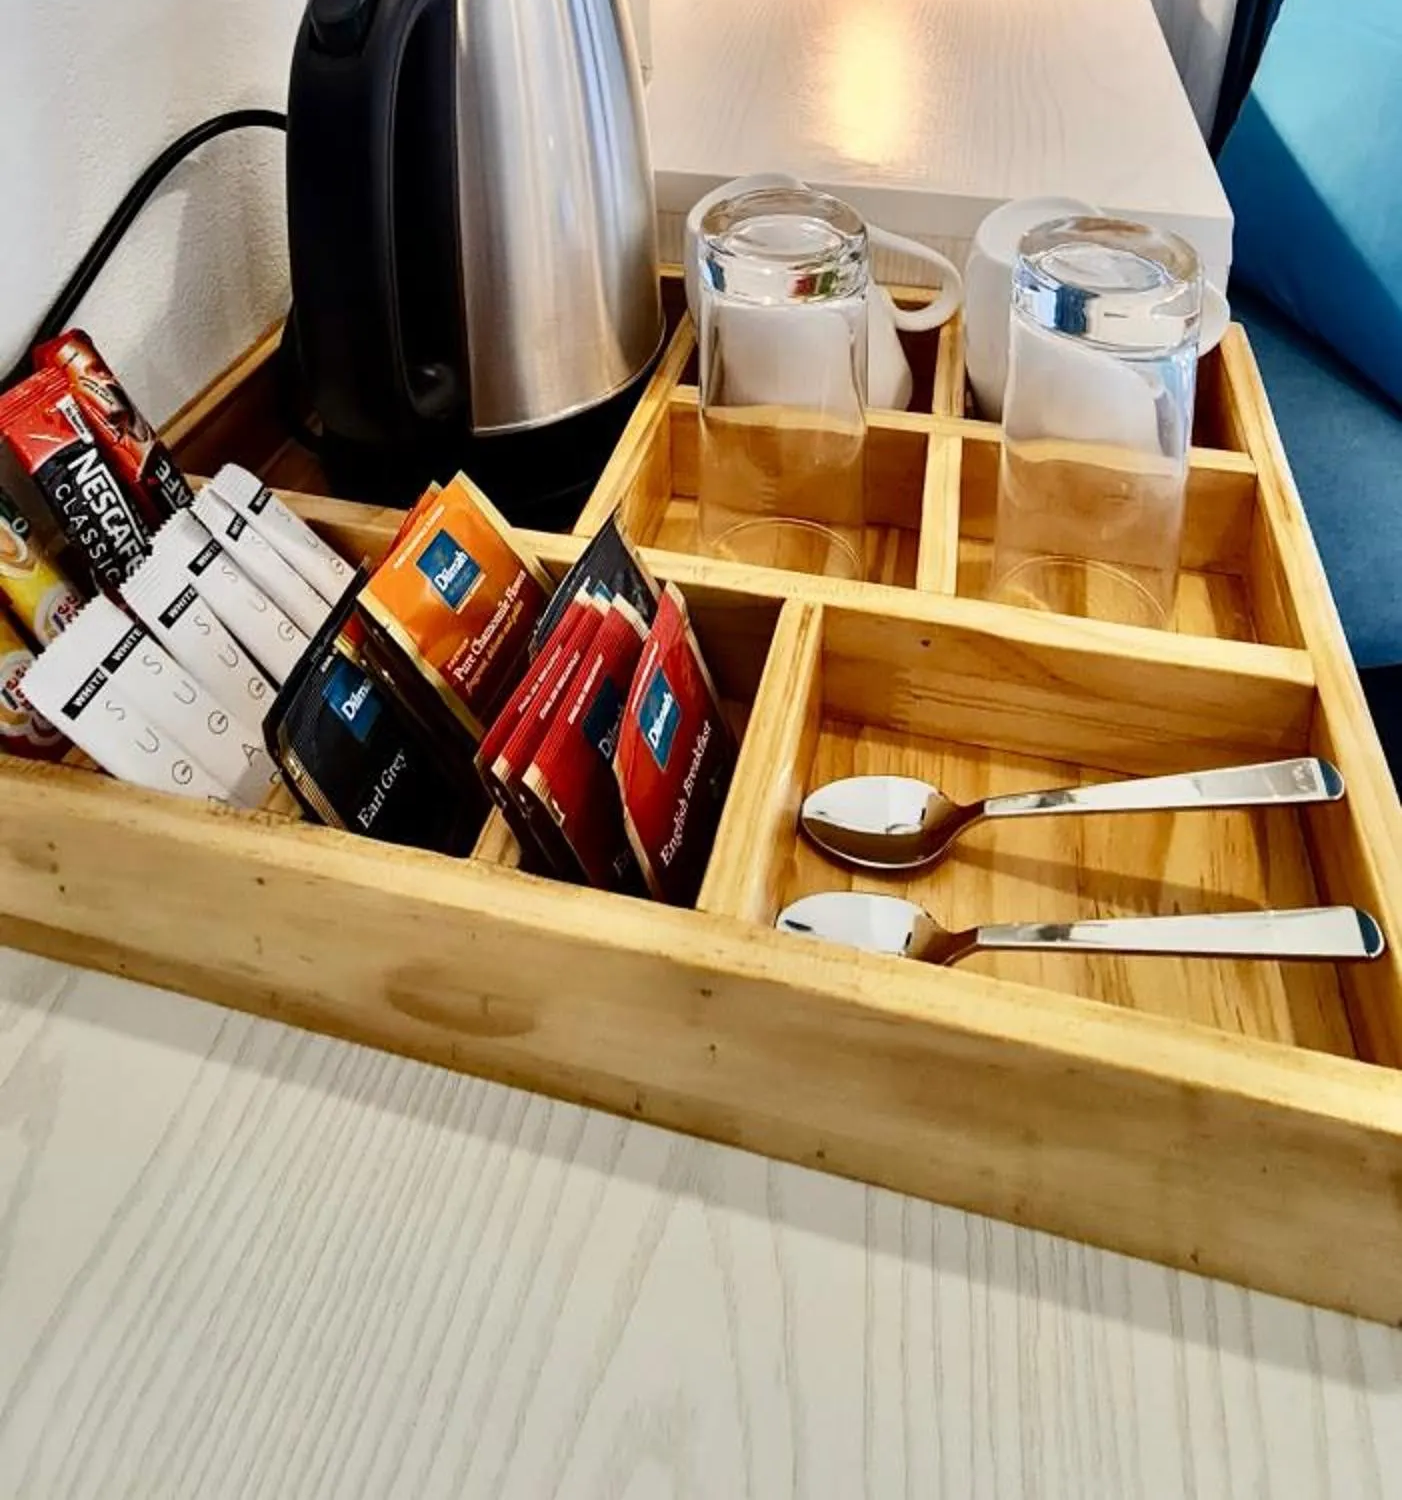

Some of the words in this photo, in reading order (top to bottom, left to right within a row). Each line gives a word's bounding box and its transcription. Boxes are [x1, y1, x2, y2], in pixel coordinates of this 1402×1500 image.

[55, 483, 121, 580] CLASSIC
[167, 587, 198, 619] WHITE
[222, 565, 295, 641] SUG
[434, 549, 469, 592] Dilmah
[112, 627, 143, 662] WHITE
[193, 615, 266, 701] SUG
[453, 652, 475, 682] Pure
[649, 692, 673, 750] Dilmah
[357, 786, 386, 829] Earl
[381, 748, 407, 790] Grey
[660, 798, 689, 867] English
[684, 719, 712, 799] Breakfast
